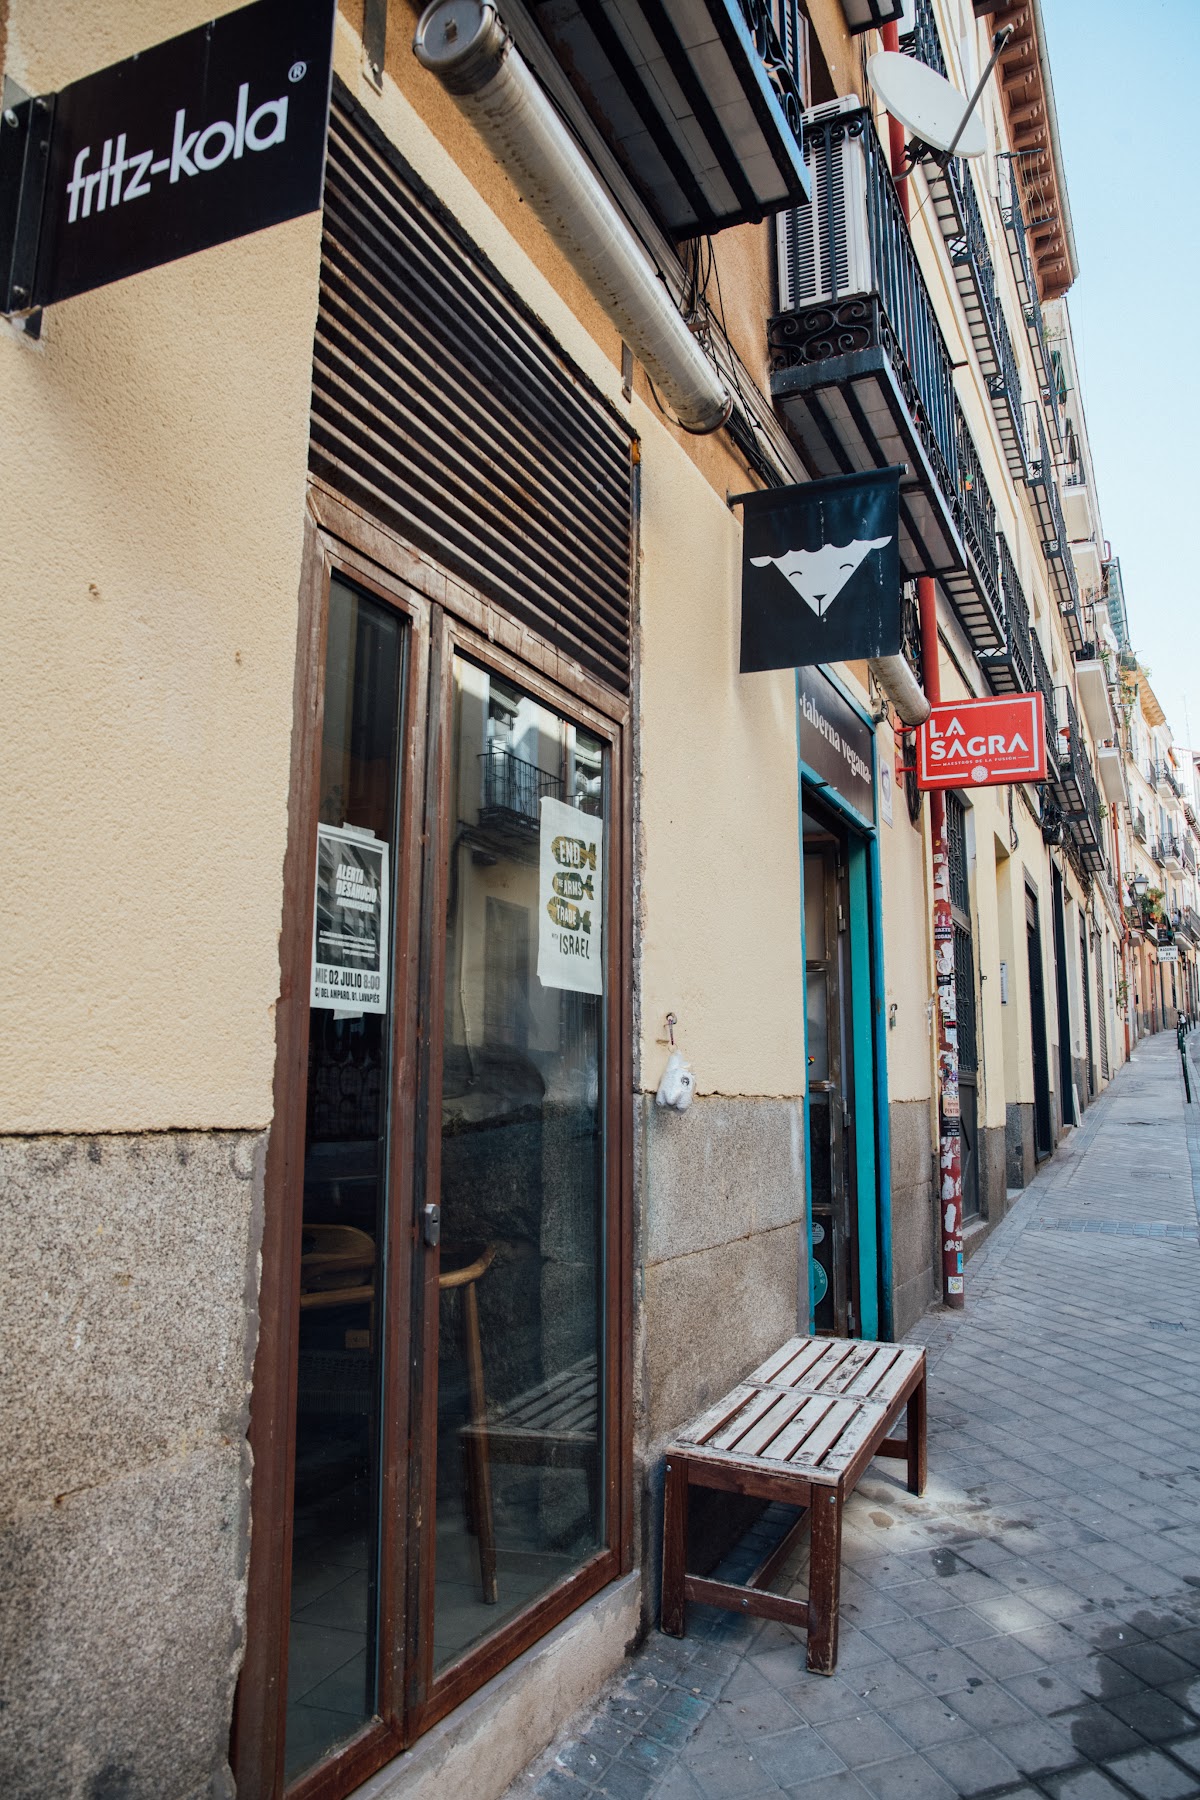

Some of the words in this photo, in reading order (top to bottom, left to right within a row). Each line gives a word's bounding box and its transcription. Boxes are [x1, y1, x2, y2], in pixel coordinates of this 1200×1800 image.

[67, 82, 289, 224] fritz-kola
[802, 692, 840, 752] taberna
[929, 716, 966, 739] LA
[930, 732, 1029, 760] SAGRA
[559, 840, 580, 865] END
[336, 864, 364, 884] ALERTA
[336, 880, 377, 903] DESAHUCIO
[564, 880, 583, 896] ARMS
[556, 905, 576, 925] TRADE
[560, 933, 590, 959] ISRAEL
[328, 969, 339, 986] 02
[340, 971, 362, 988] JULIO
[363, 974, 380, 991] 8:00
